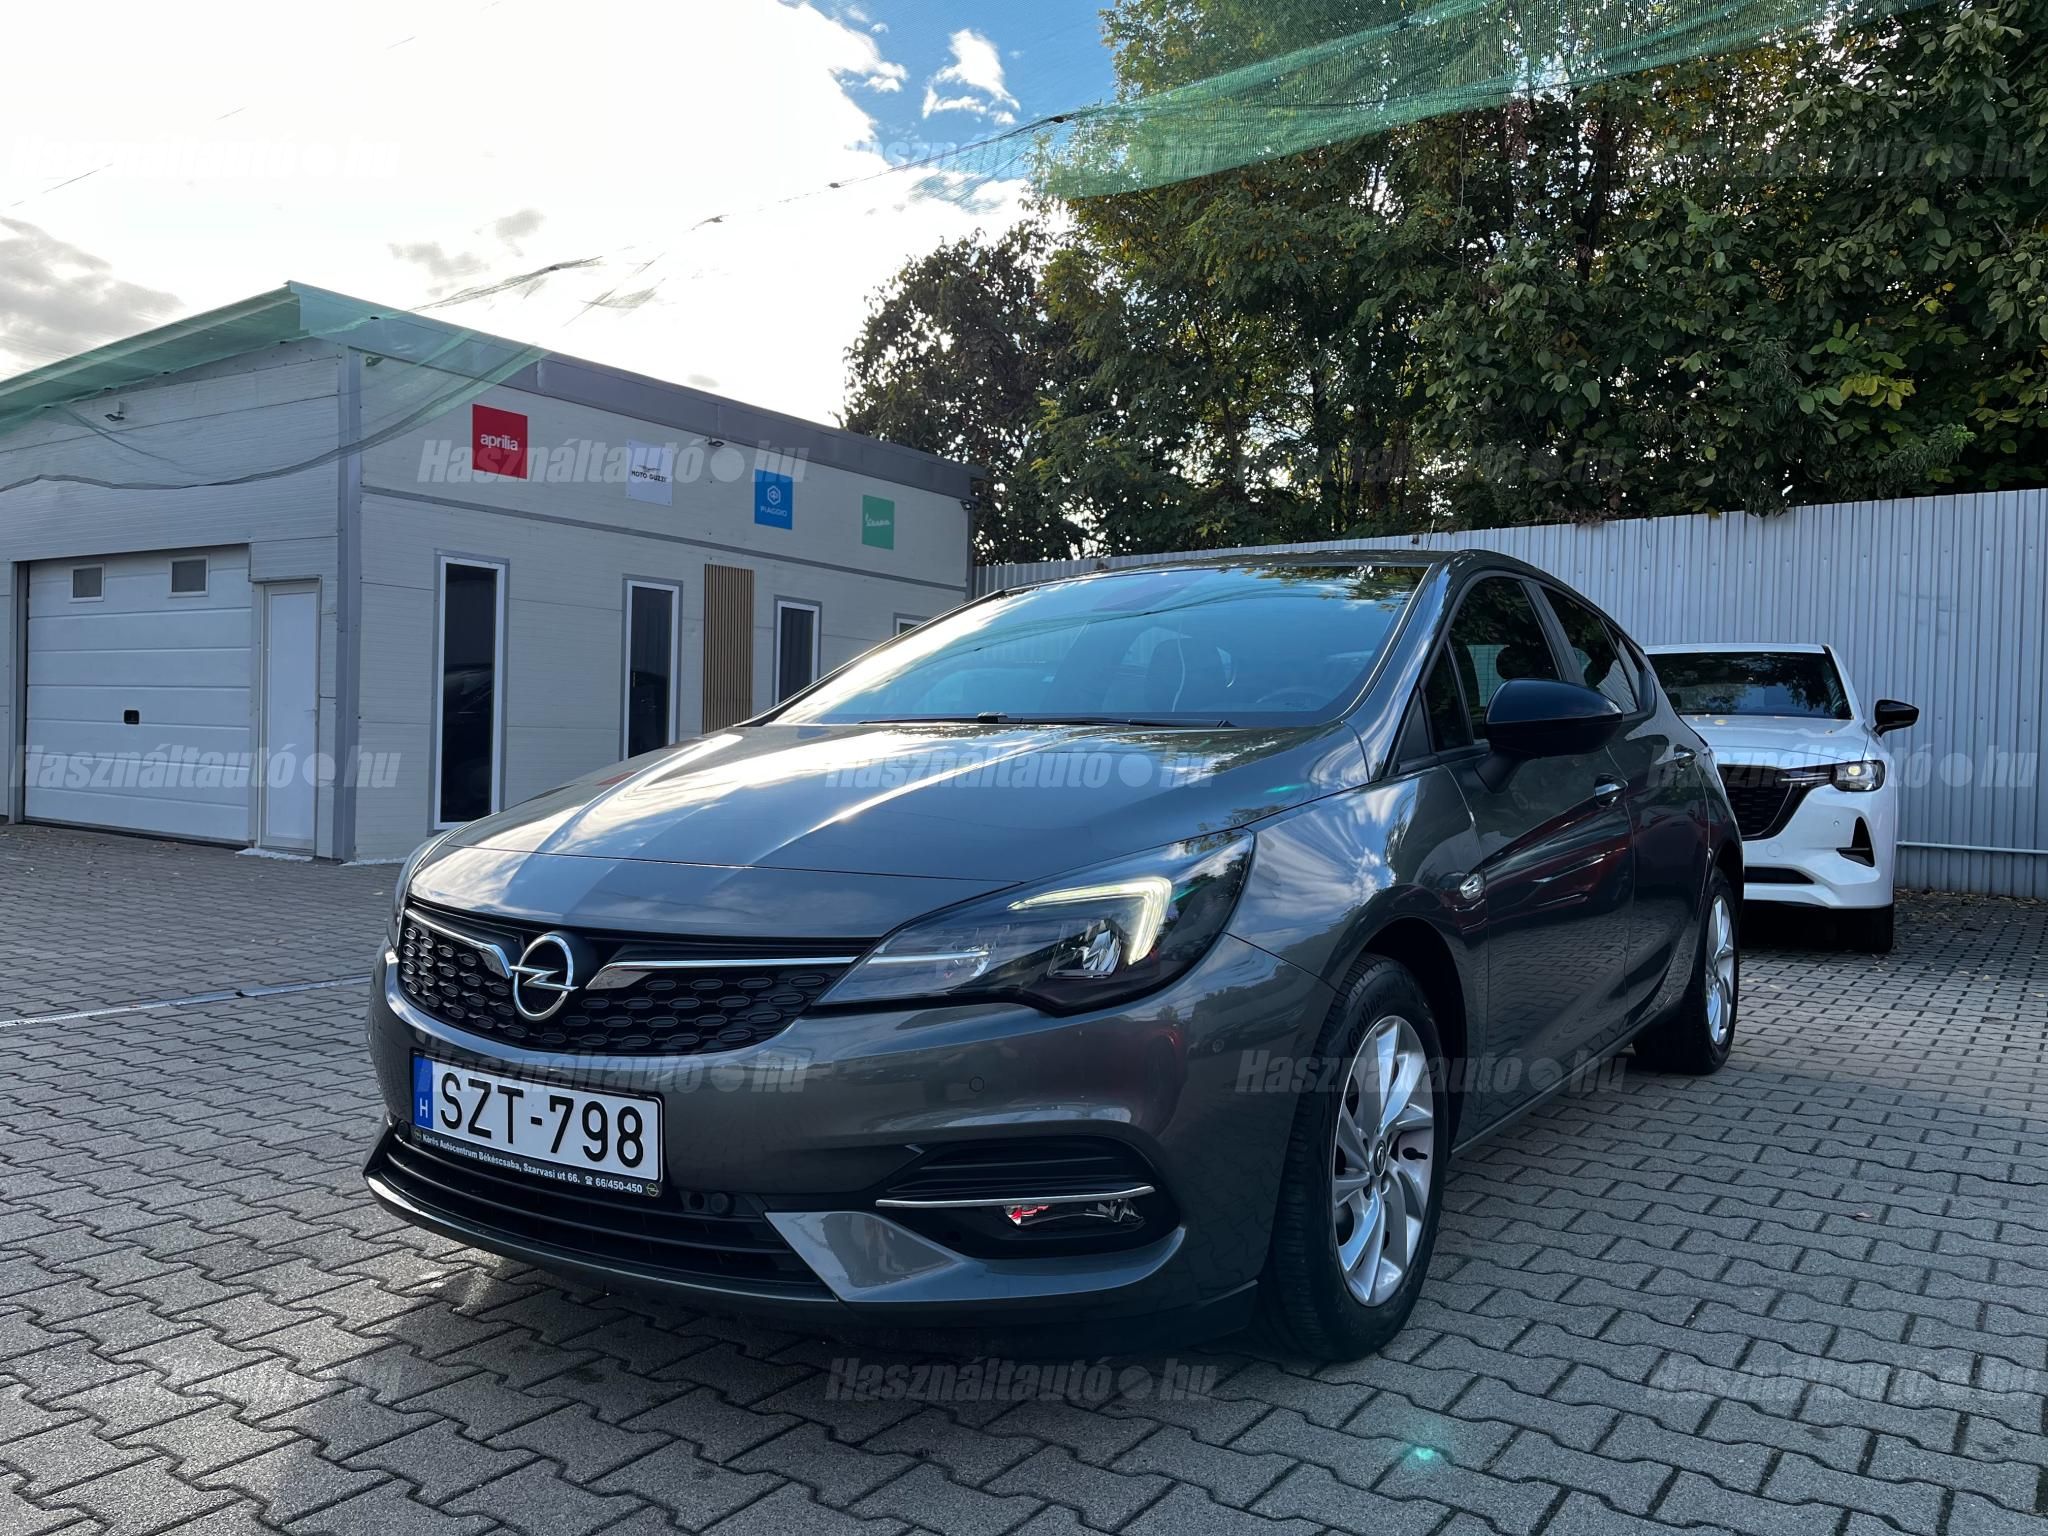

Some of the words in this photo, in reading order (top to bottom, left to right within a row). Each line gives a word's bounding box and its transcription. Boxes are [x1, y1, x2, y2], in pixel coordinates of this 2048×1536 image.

[480, 433, 518, 451] aprilia
[631, 470, 647, 479] MOTO
[760, 505, 788, 517] PIAGGIO
[865, 512, 891, 527] Vespa
[420, 1098, 428, 1118] H
[440, 1072, 644, 1168] SZT-798
[479, 1151, 522, 1172] Békéscsaba,
[523, 1162, 556, 1178] Szarvasi
[567, 1173, 580, 1183] 66.
[595, 1177, 643, 1193] 66/450-450
